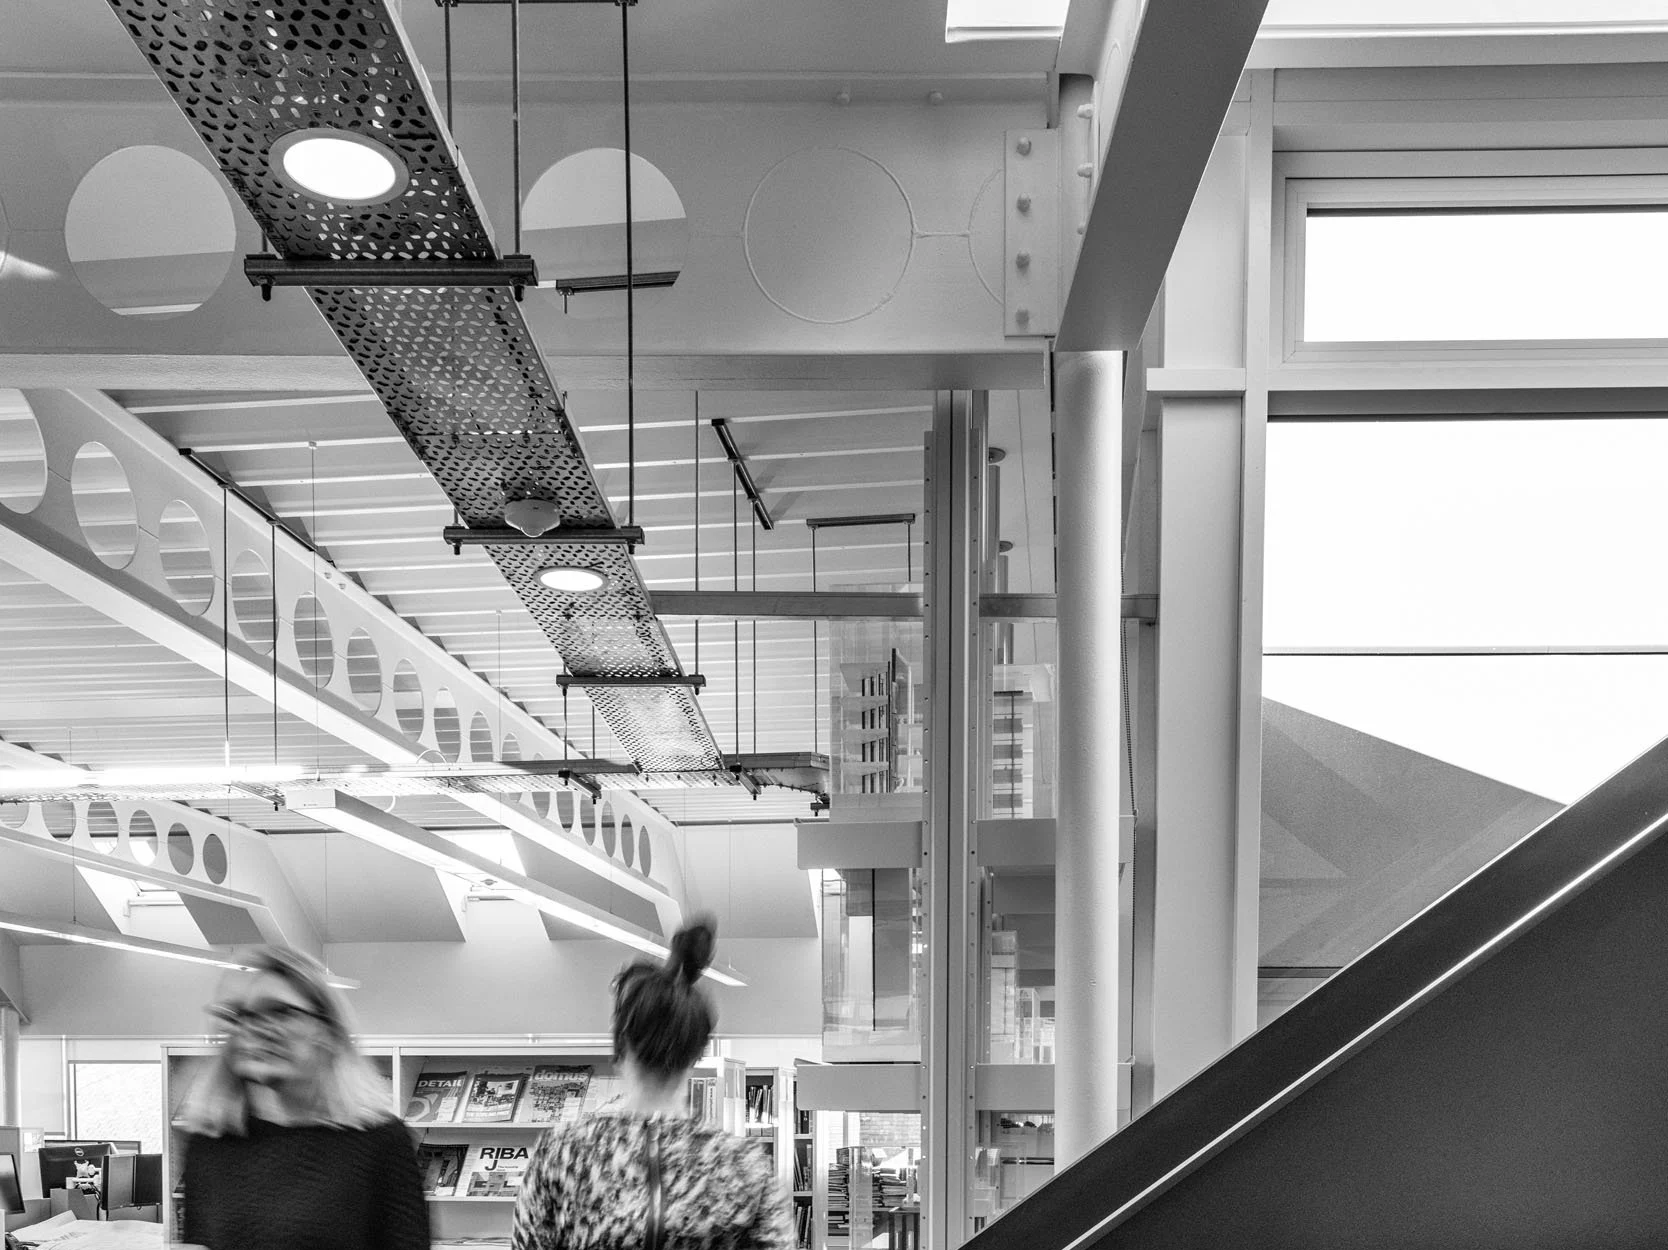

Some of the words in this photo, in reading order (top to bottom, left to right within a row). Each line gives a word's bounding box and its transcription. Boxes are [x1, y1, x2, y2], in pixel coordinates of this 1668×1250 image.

[534, 1069, 589, 1080] domus
[418, 1079, 462, 1088] DETAIL
[480, 1147, 528, 1159] RIBA
[484, 1160, 498, 1171] J
